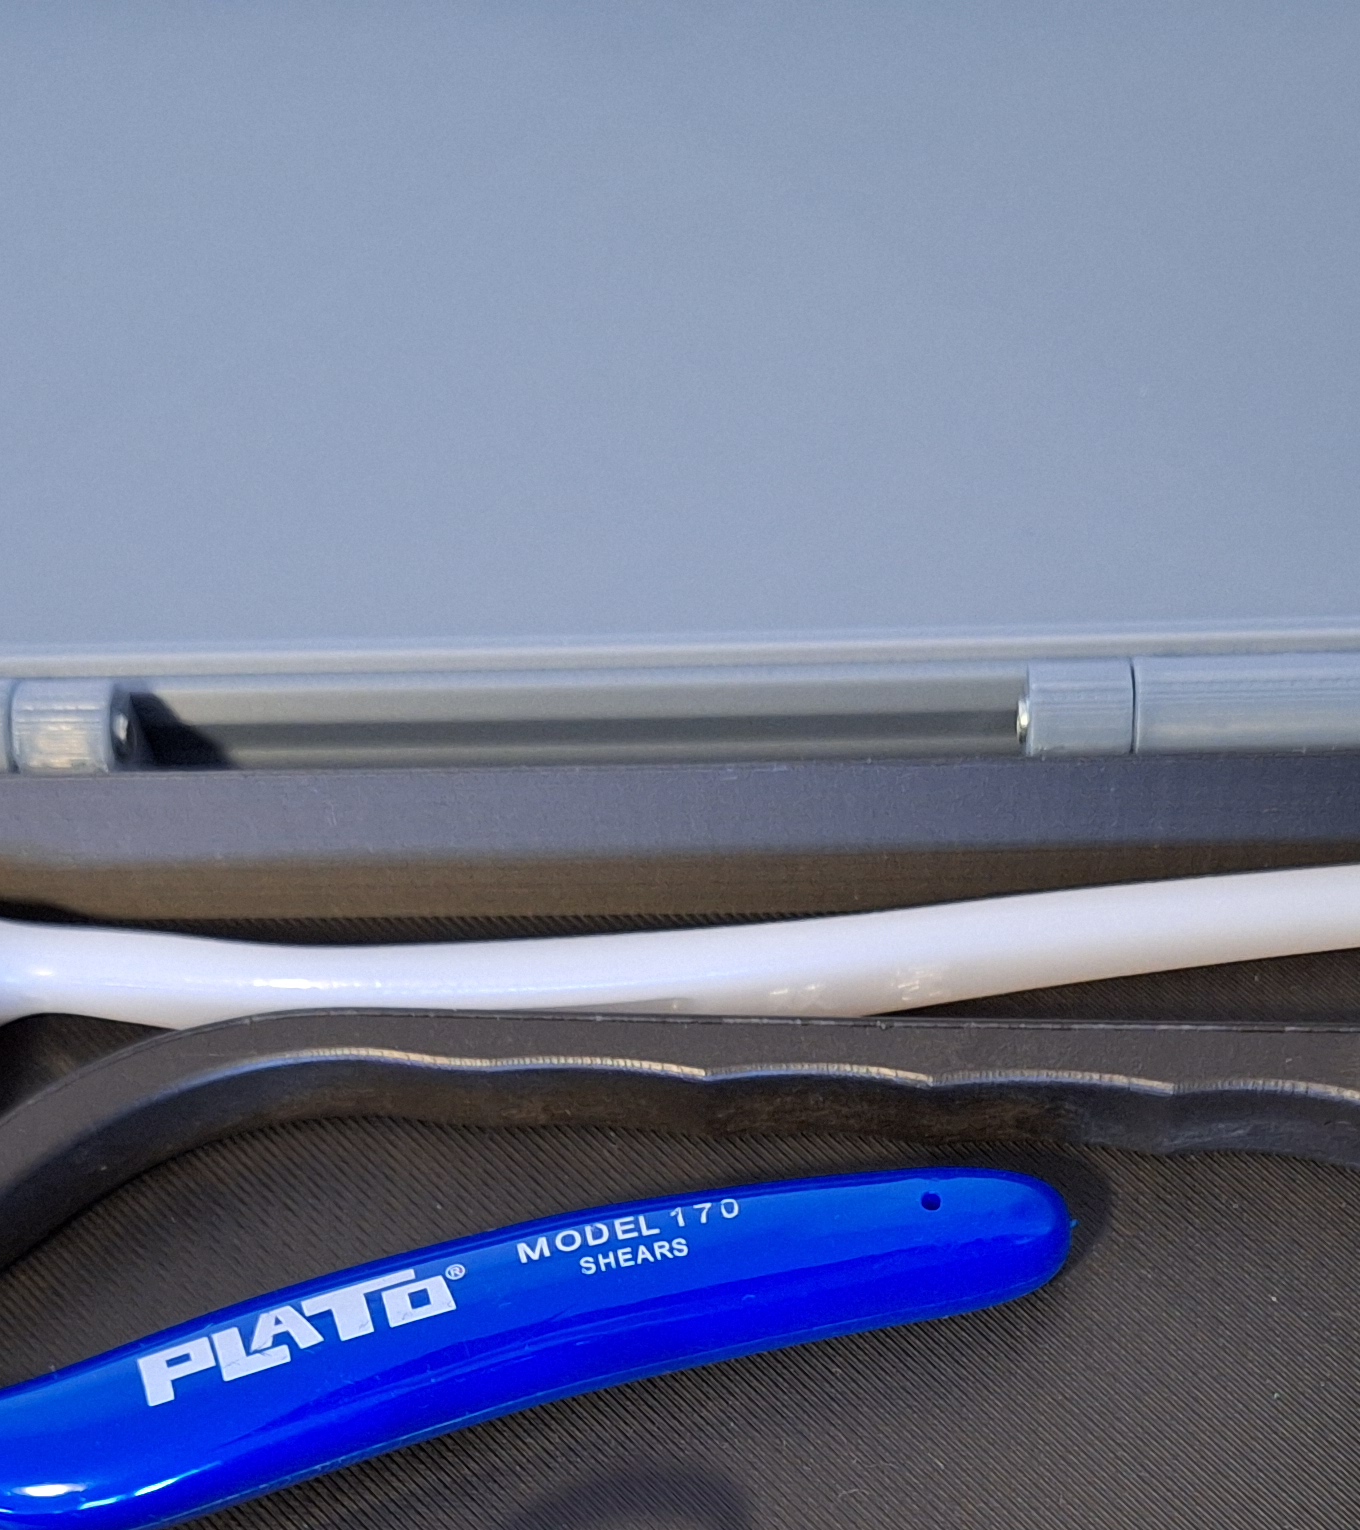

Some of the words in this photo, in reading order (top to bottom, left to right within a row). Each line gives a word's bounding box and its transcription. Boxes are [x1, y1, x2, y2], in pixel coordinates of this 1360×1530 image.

[515, 1215, 661, 1264] MODEL
[669, 1197, 740, 1228] 170
[579, 1237, 689, 1275] SHEARS
